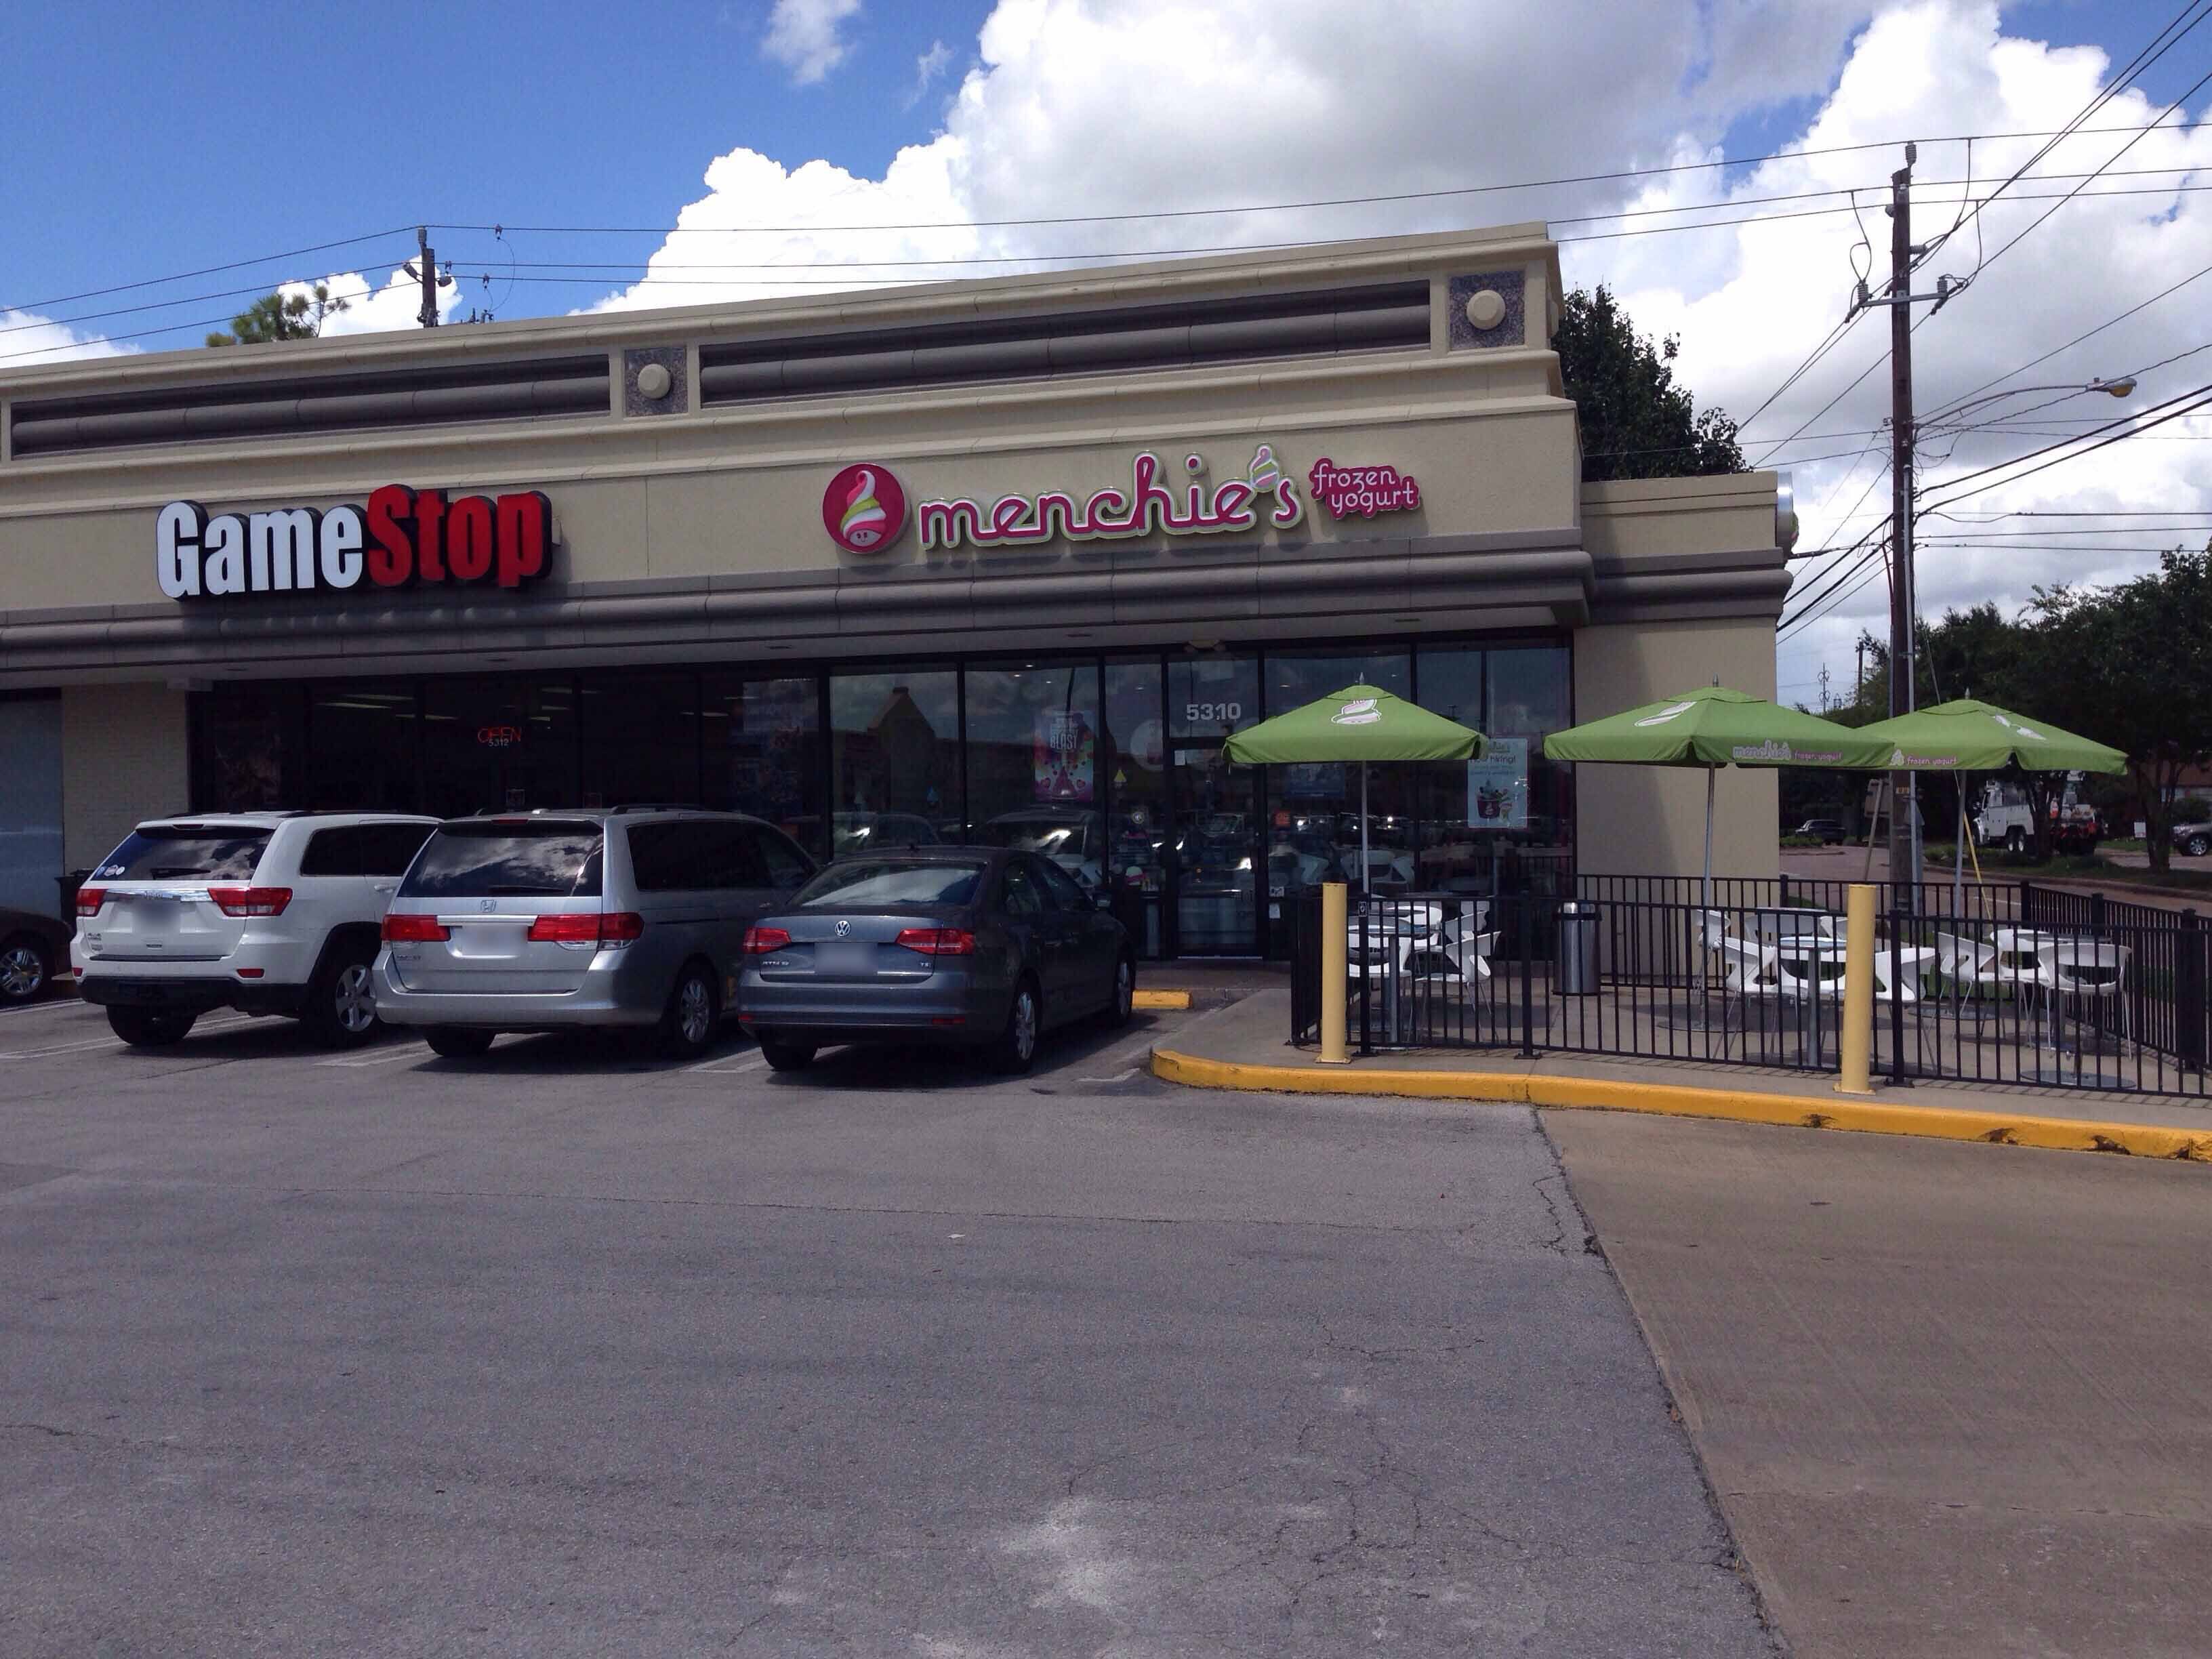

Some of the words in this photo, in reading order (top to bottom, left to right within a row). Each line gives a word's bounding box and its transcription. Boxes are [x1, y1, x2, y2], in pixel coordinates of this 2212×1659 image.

[1314, 462, 1396, 495] frozen
[918, 444, 1303, 550] menchie's
[1332, 481, 1414, 514] yogurt
[157, 484, 544, 599] GameStop
[1187, 703, 1242, 721] 5310
